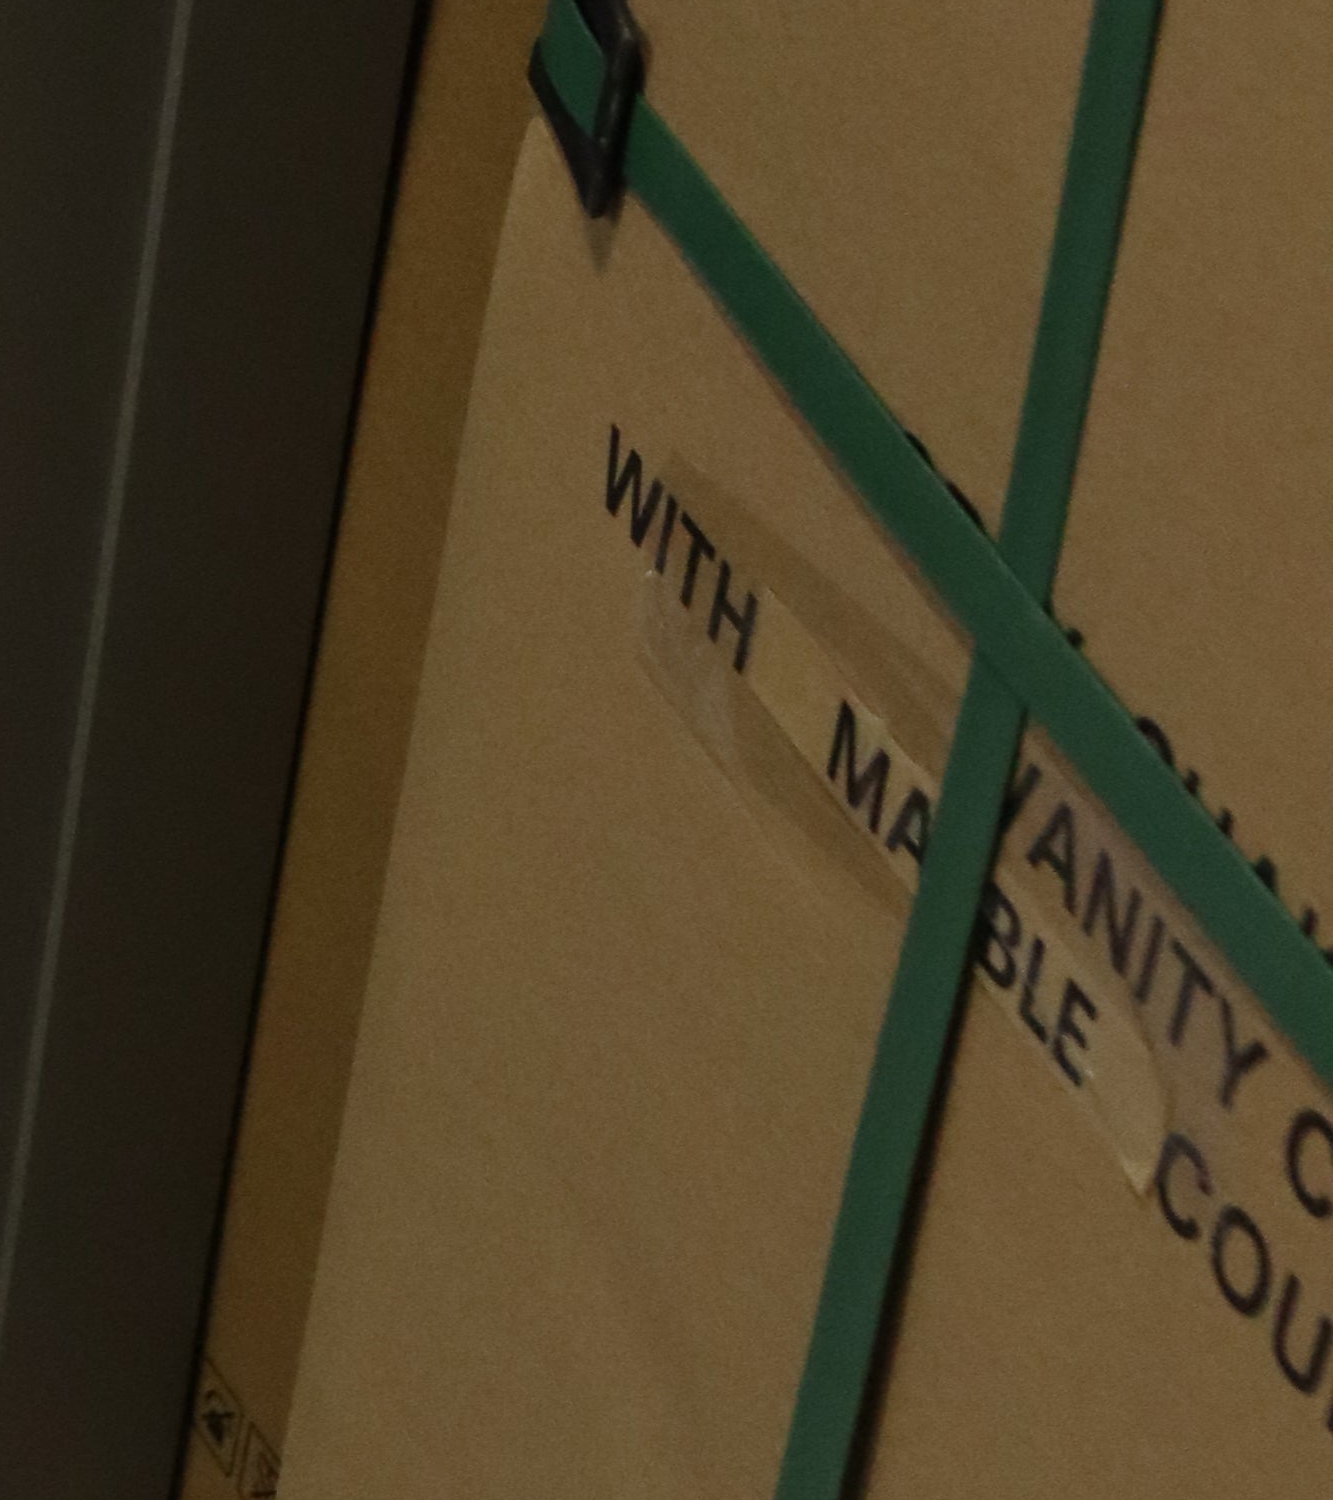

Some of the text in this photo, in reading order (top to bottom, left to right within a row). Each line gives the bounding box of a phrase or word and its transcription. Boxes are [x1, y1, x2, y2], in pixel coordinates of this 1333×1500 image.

[603, 422, 761, 674] WITH
[826, 700, 1099, 1087] MABLE
[1155, 1131, 1333, 1432] COU
